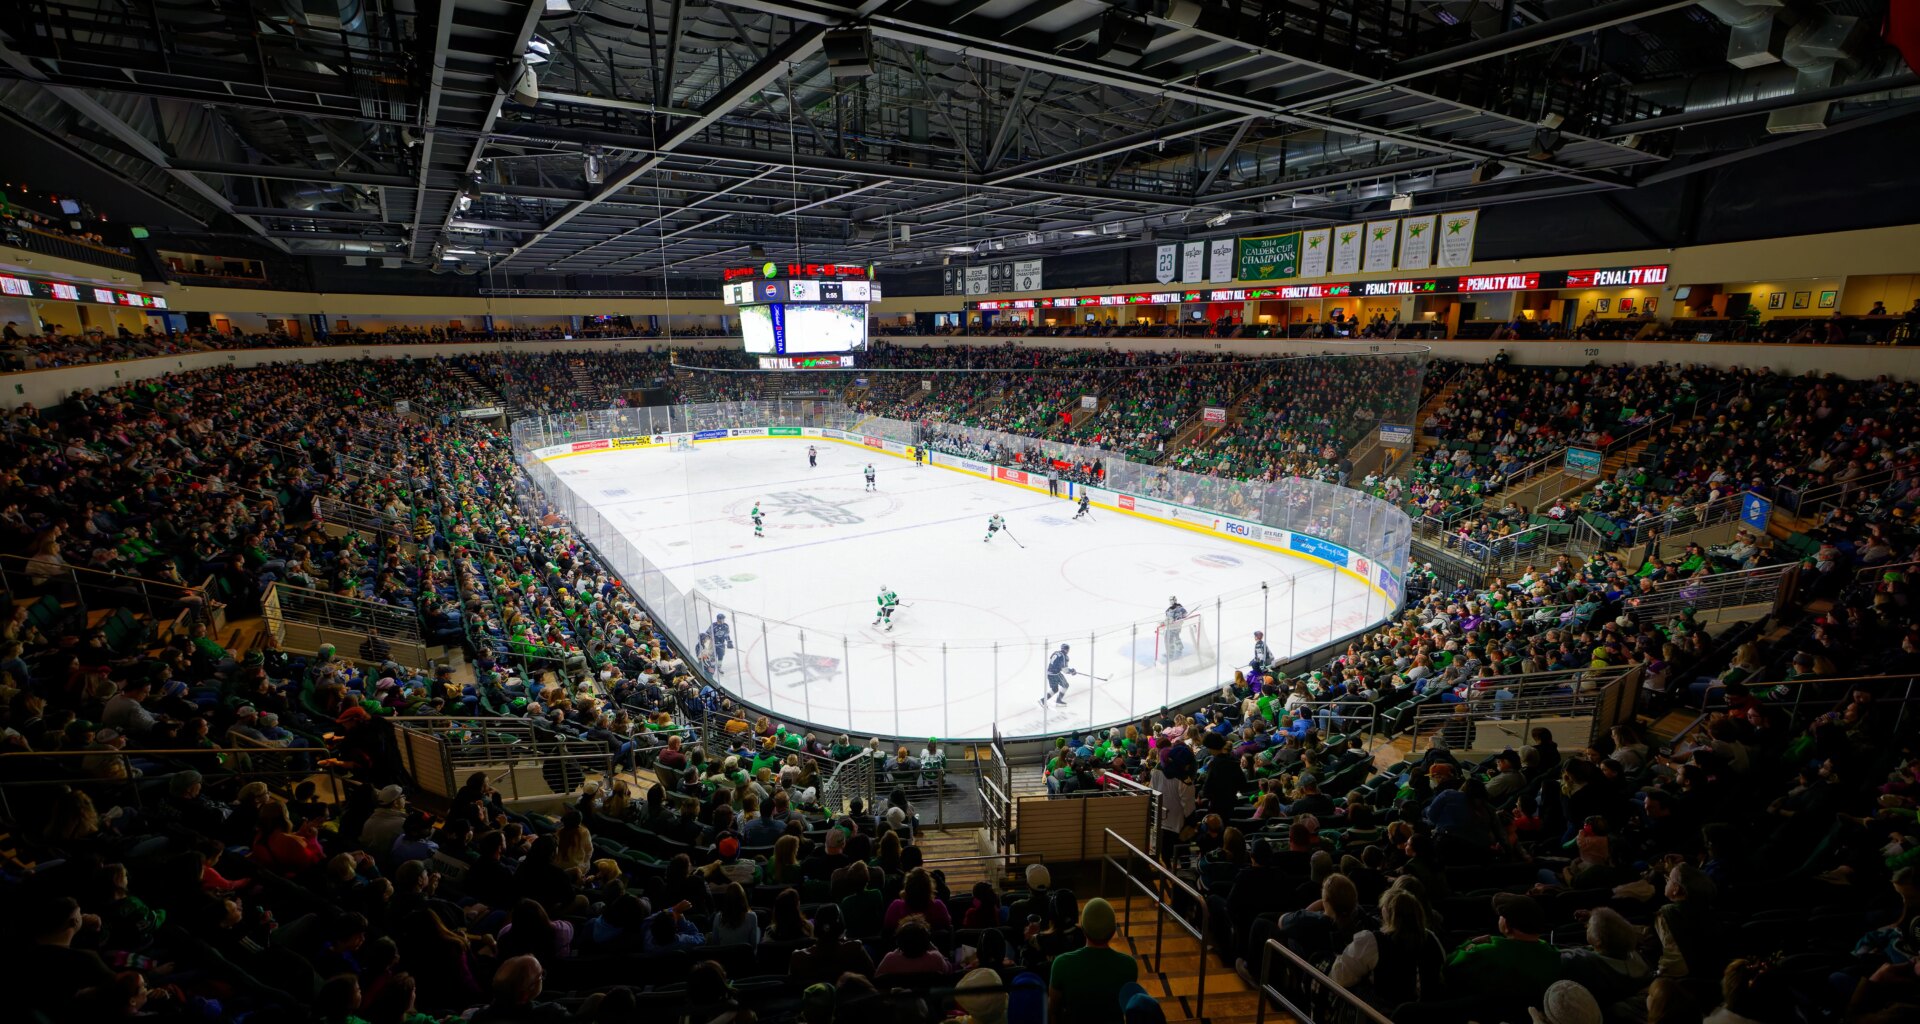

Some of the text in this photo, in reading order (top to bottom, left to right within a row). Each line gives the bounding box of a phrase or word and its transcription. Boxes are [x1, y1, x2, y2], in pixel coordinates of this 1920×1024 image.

[1246, 244, 1293, 256] CALDER CUP
[1160, 254, 1173, 272] 23
[1242, 251, 1295, 265] CHAMPIONS
[1467, 275, 1527, 291] PENALTY KILL
[1593, 270, 1643, 286] PENALTY
[1281, 286, 1322, 298] PENALTY KILL
[1365, 281, 1414, 295] PENALTY KILL
[1100, 296, 1125, 305] PENALTY KILL
[1151, 292, 1180, 303] PENALTY KILL
[1211, 289, 1245, 300] PENALTY KILL
[1585, 348, 1599, 356] 120
[779, 357, 795, 369] KILL
